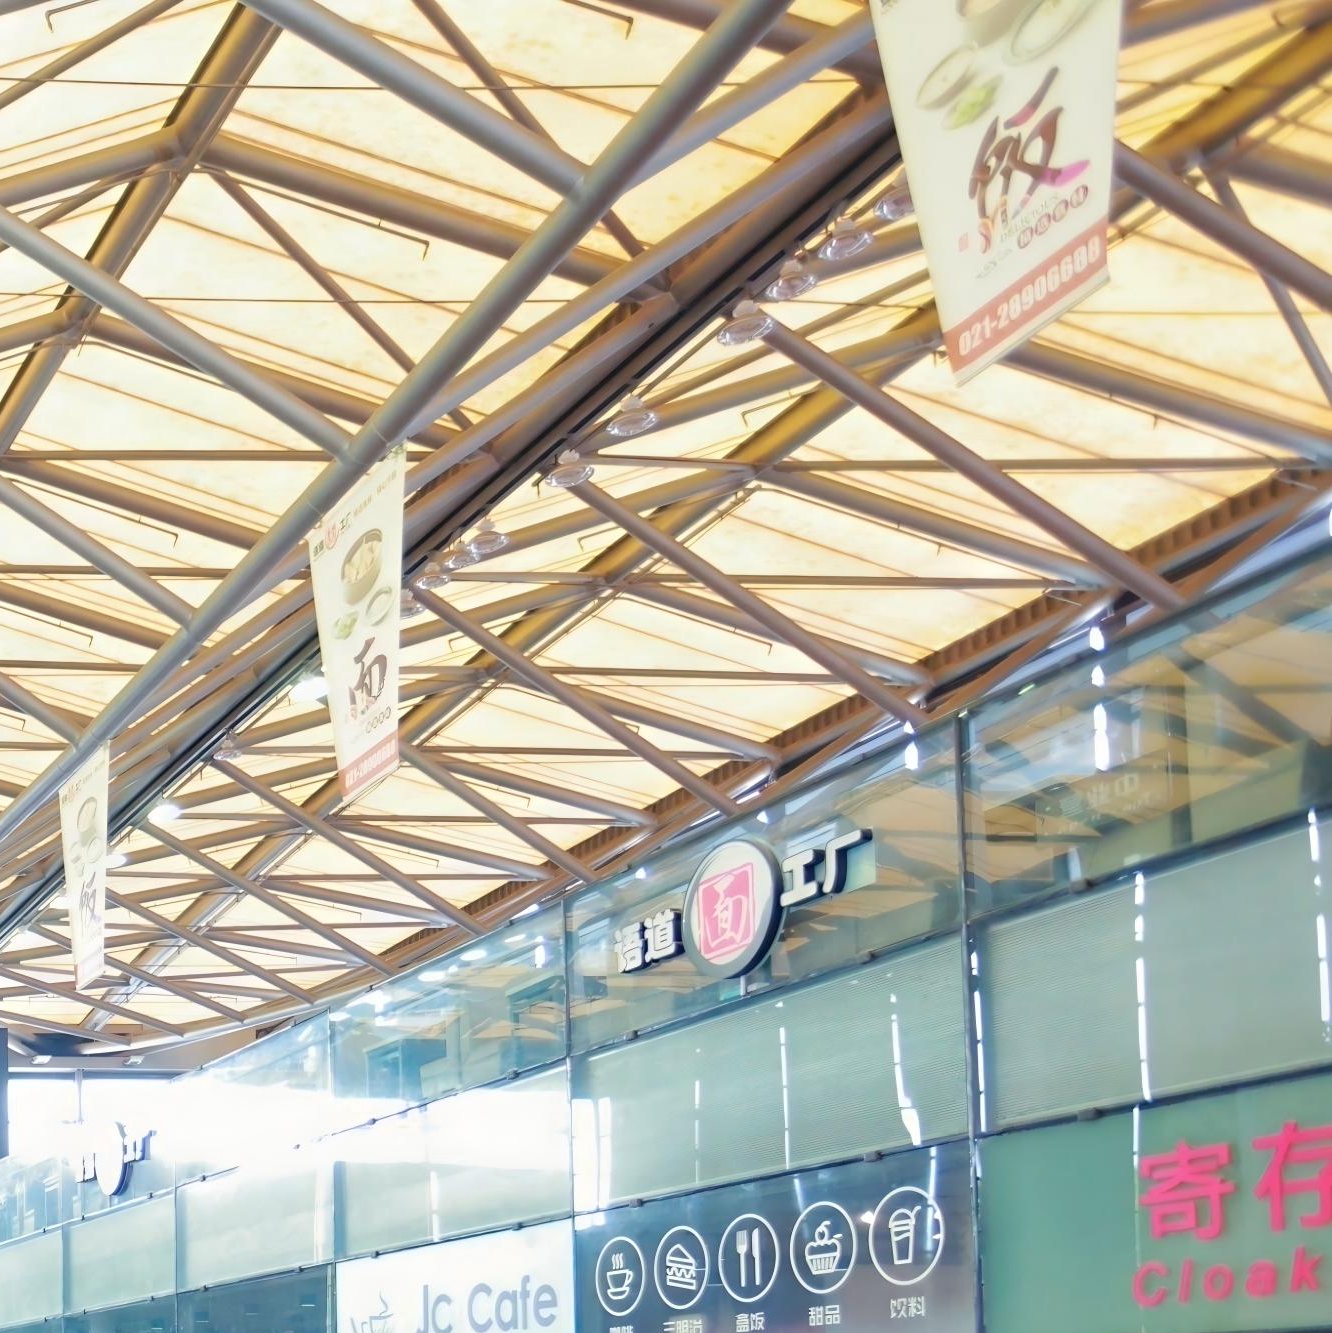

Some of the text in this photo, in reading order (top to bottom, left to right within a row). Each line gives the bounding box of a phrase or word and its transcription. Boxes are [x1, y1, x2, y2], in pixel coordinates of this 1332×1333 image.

[1132, 1245, 1324, 1308] Cloak
[468, 1274, 558, 1333] Cafe
[808, 1304, 841, 1327] 甜品
[890, 1296, 926, 1320] 饮料
[735, 1312, 765, 1333] 盒饭
